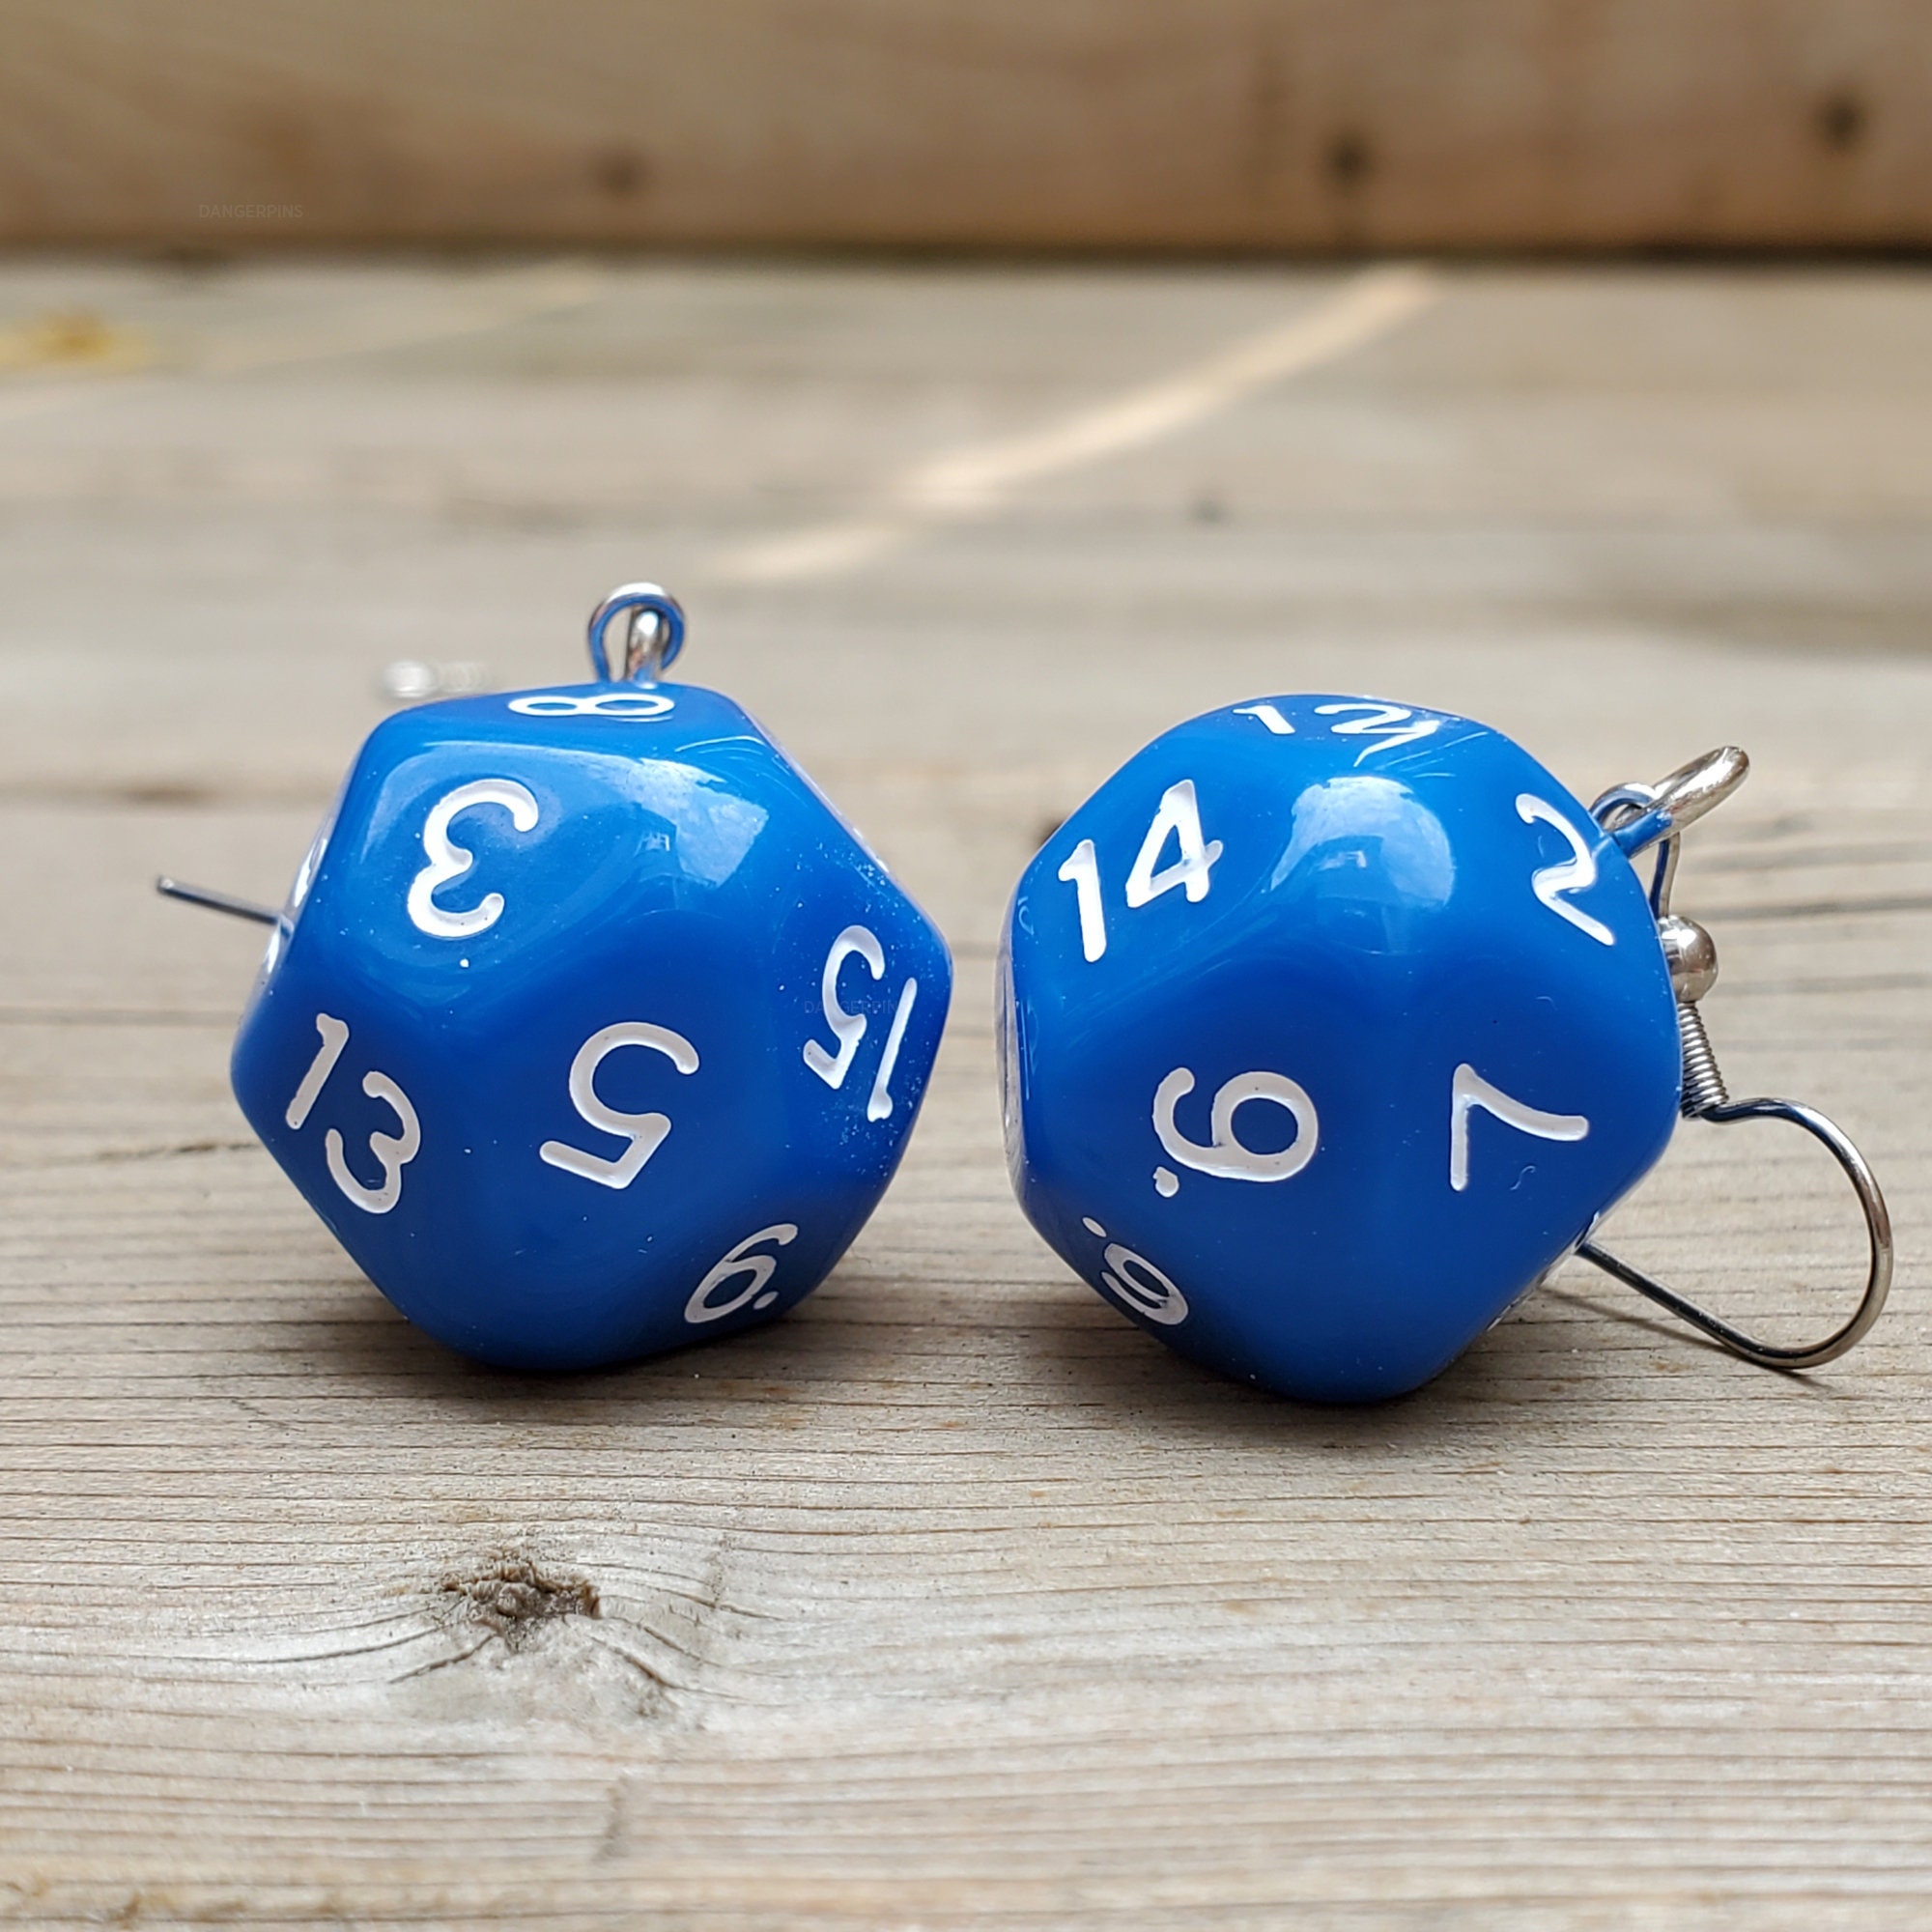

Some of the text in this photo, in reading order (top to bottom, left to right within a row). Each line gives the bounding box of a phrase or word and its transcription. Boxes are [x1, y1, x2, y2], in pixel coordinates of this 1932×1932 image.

[508, 692, 674, 716] 8
[1233, 704, 1440, 767] 12
[408, 779, 539, 938] 3
[1059, 779, 1223, 963] 14
[1516, 794, 1615, 946] 2
[804, 925, 917, 1122] 15
[285, 1013, 421, 1214] 13
[539, 1022, 699, 1190] 5
[1450, 1064, 1590, 1192] 7
